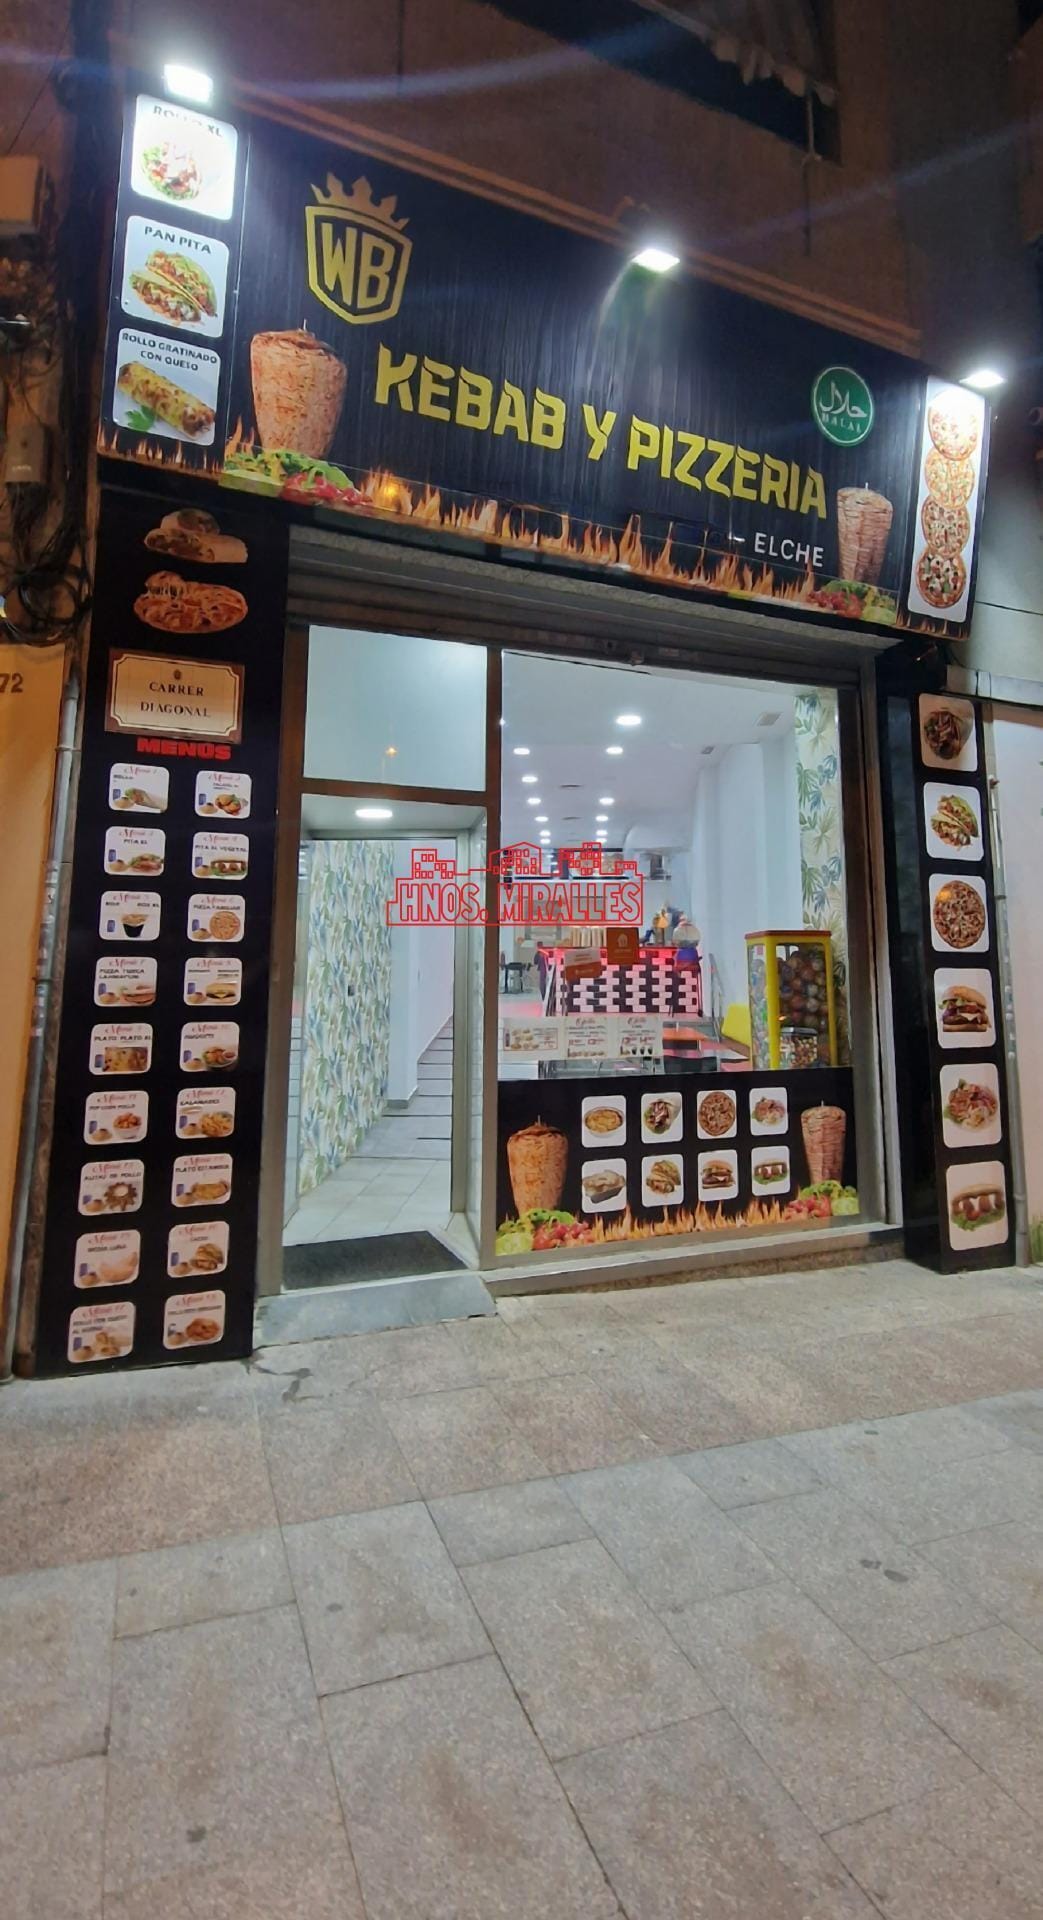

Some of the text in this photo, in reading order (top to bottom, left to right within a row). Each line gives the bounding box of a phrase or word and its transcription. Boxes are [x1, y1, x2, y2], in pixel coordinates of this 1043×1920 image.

[207, 124, 223, 137] XL
[144, 225, 212, 255] PAN PITA
[321, 222, 396, 309] WB
[122, 333, 218, 364] ROLLO GRATINADO
[140, 350, 198, 371] CON QUESO
[375, 342, 828, 519] KEBAB Y PIZZERIA
[754, 532, 824, 568] ELCHE
[149, 681, 204, 697] CARRER
[140, 701, 211, 717] DIAGONAL
